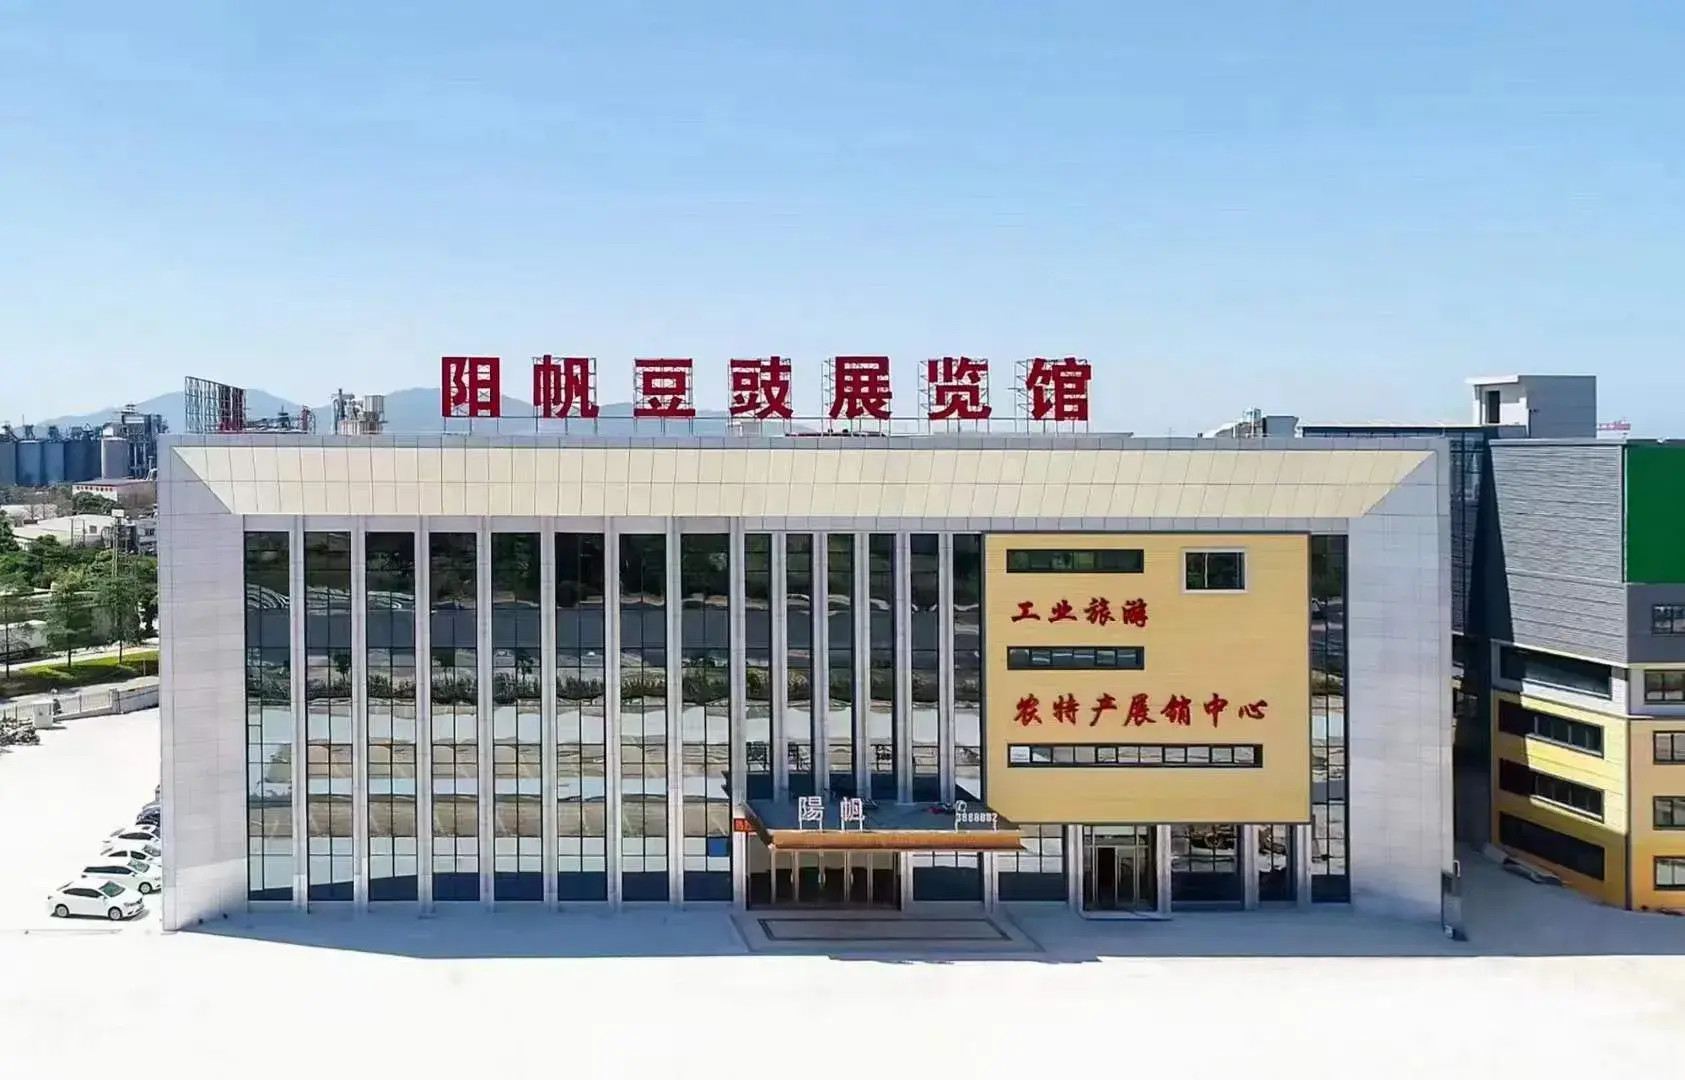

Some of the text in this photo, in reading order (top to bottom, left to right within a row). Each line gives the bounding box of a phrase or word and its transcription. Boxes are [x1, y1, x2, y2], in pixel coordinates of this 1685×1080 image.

[441, 355, 1092, 420] 阳帆豆豉展览馆
[1011, 597, 1149, 627] 工业旅游
[1014, 693, 1269, 727] 农特产展销中心
